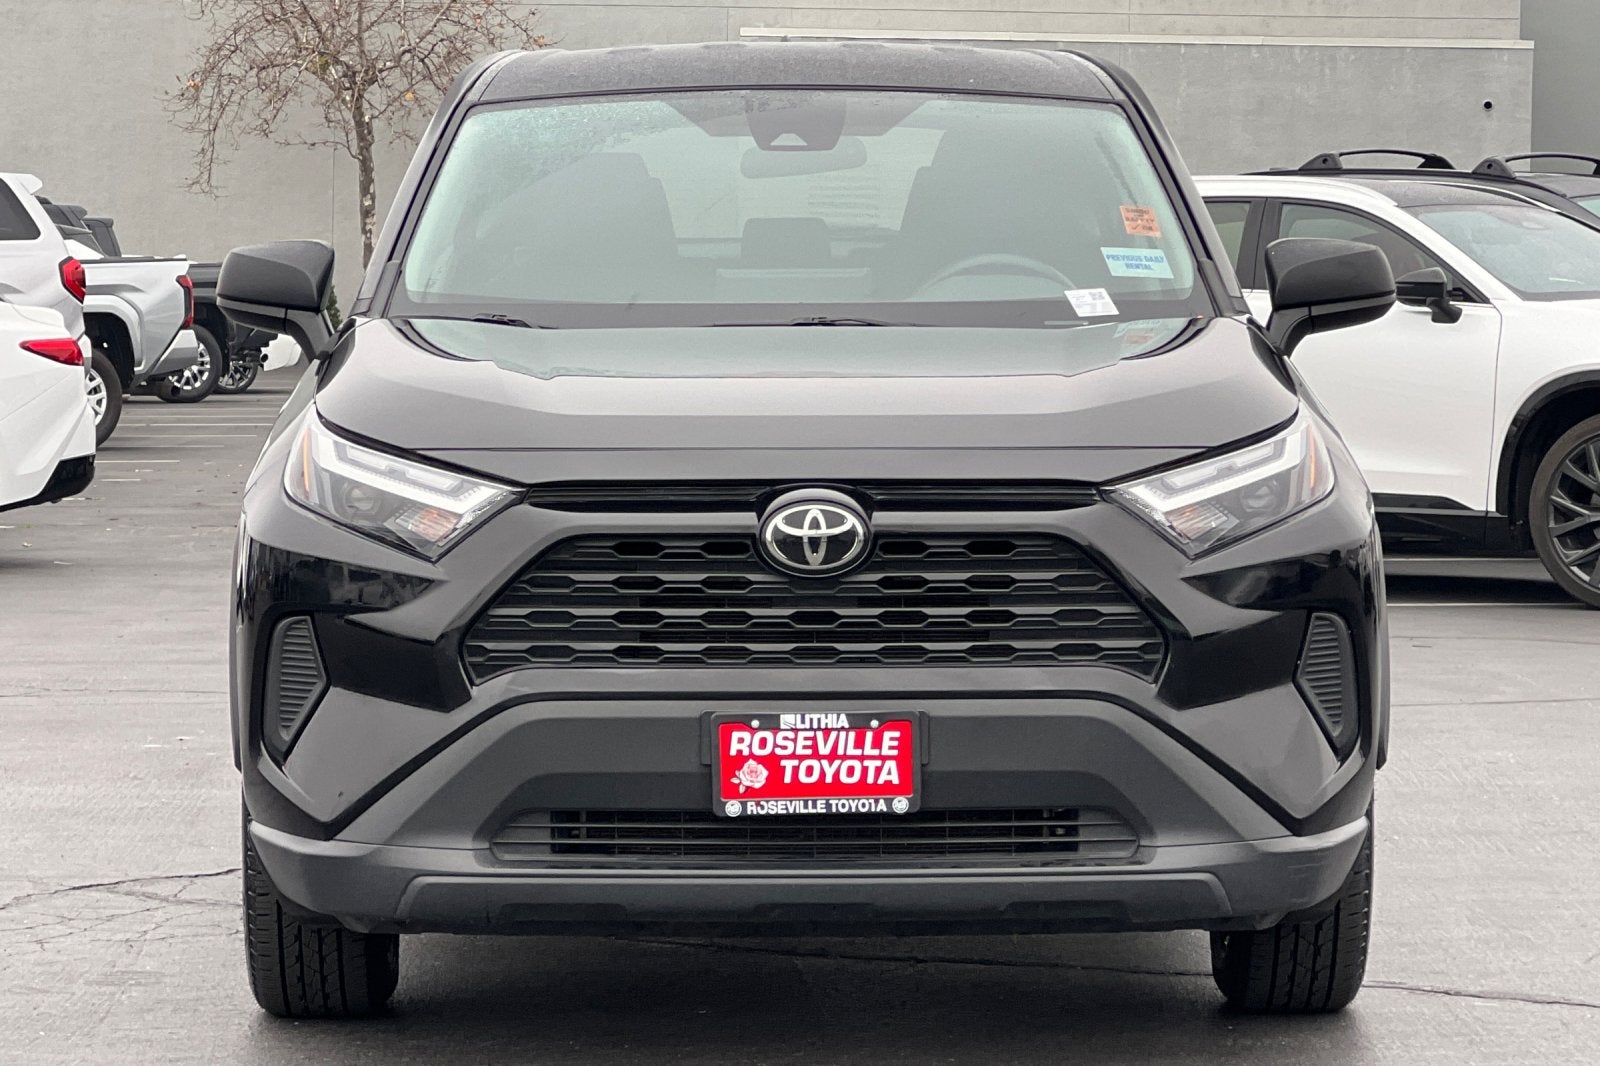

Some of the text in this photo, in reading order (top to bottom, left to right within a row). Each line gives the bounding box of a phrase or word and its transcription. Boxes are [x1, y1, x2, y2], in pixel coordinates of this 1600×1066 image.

[1106, 254, 1164, 263] PREVIOUS DAILY
[1125, 262, 1153, 270] RENTAL
[795, 713, 849, 729] LITHIA
[729, 730, 901, 757] ROSEVILLE
[780, 759, 900, 785] TOYOTA
[746, 798, 887, 815] ROSEVILLE TOYOTA
